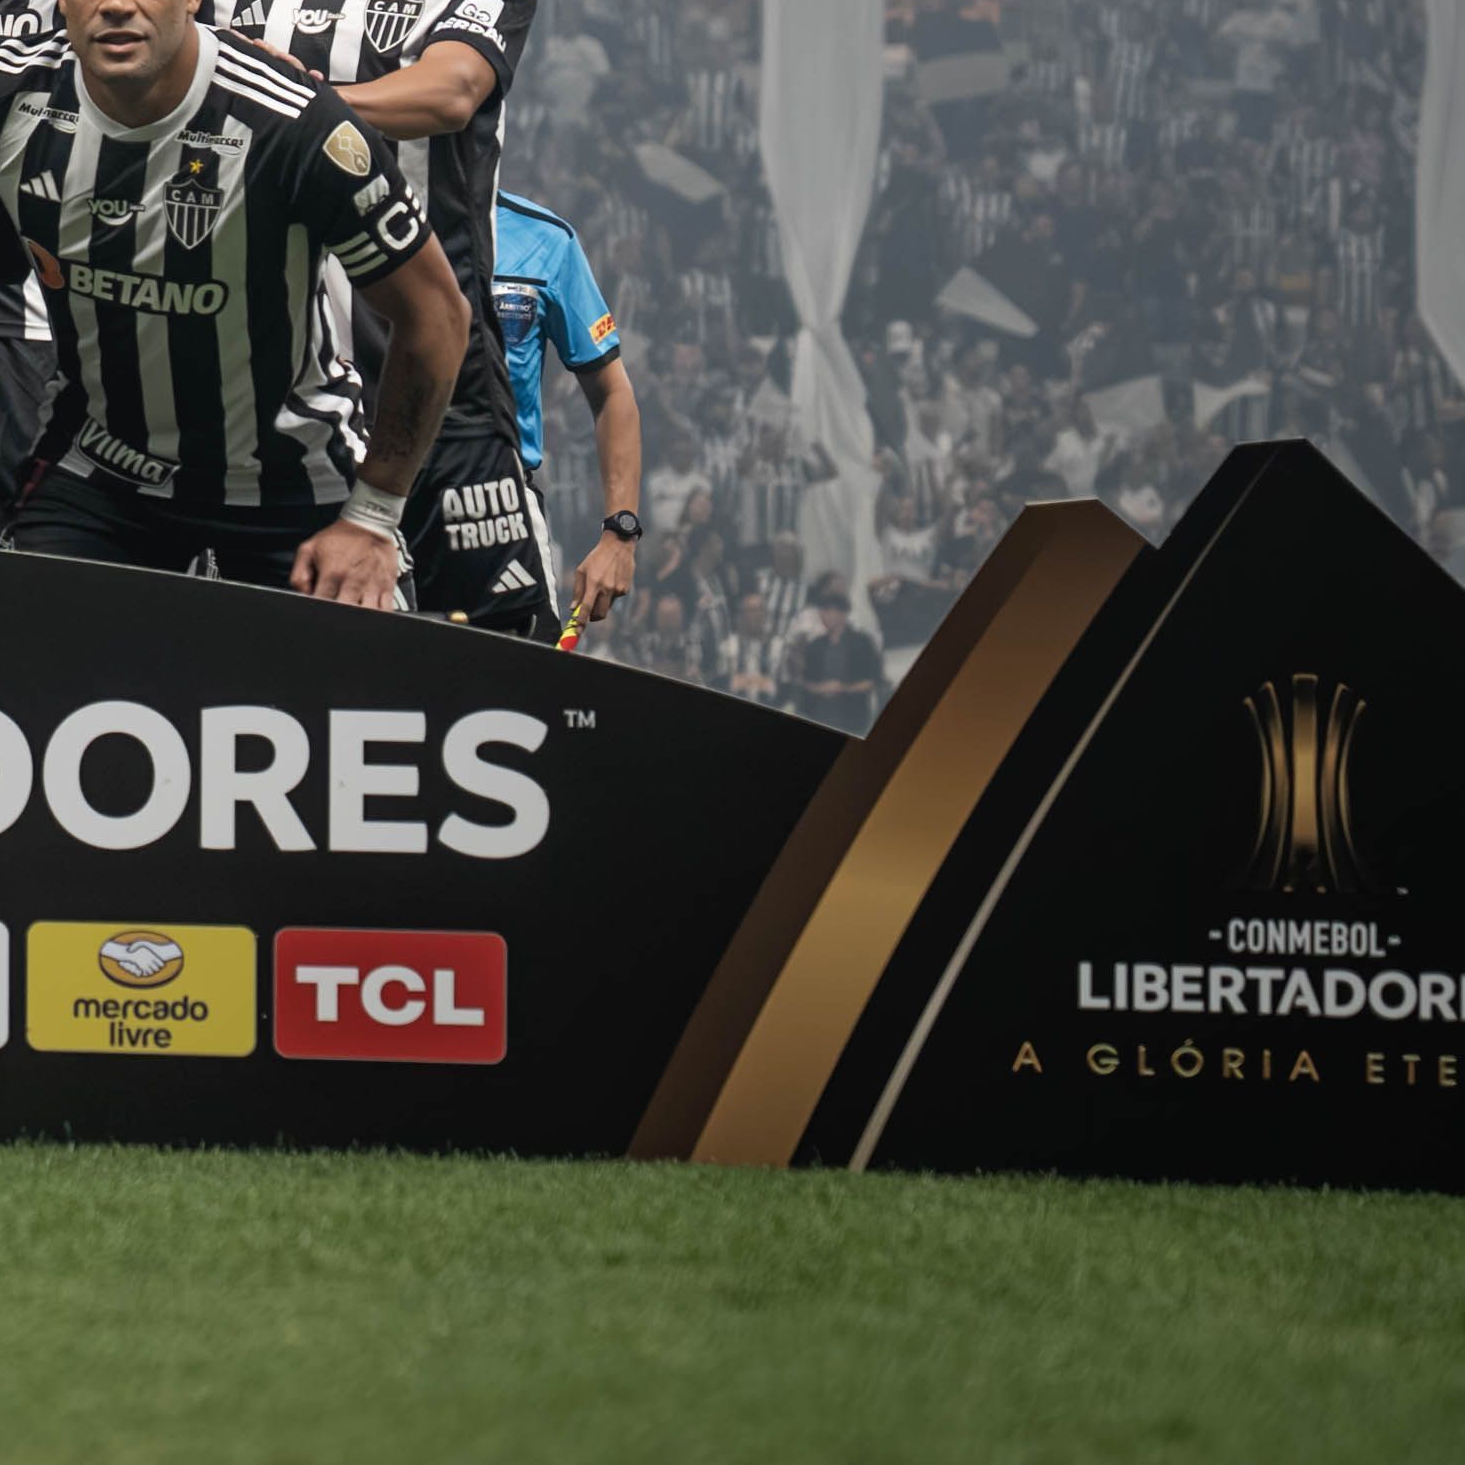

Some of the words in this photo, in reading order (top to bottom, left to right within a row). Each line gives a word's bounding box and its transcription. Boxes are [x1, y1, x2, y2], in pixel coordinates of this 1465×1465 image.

[373, 0, 418, 16] CAM
[88, 199, 127, 216] YOU
[172, 189, 215, 205] CAM
[377, 201, 419, 251] C
[70, 264, 225, 314] BETANO
[81, 421, 164, 482] Vilma
[443, 478, 519, 522] AUTO
[445, 512, 528, 551] TRUCK
[73, 994, 209, 1022] mercado
[296, 965, 485, 1026] TCL
[1078, 962, 1465, 1021] LIBERTADOR
[109, 1022, 172, 1048] livre
[1012, 1042, 1043, 1074] A
[1086, 1039, 1320, 1082] GLÓRIA
